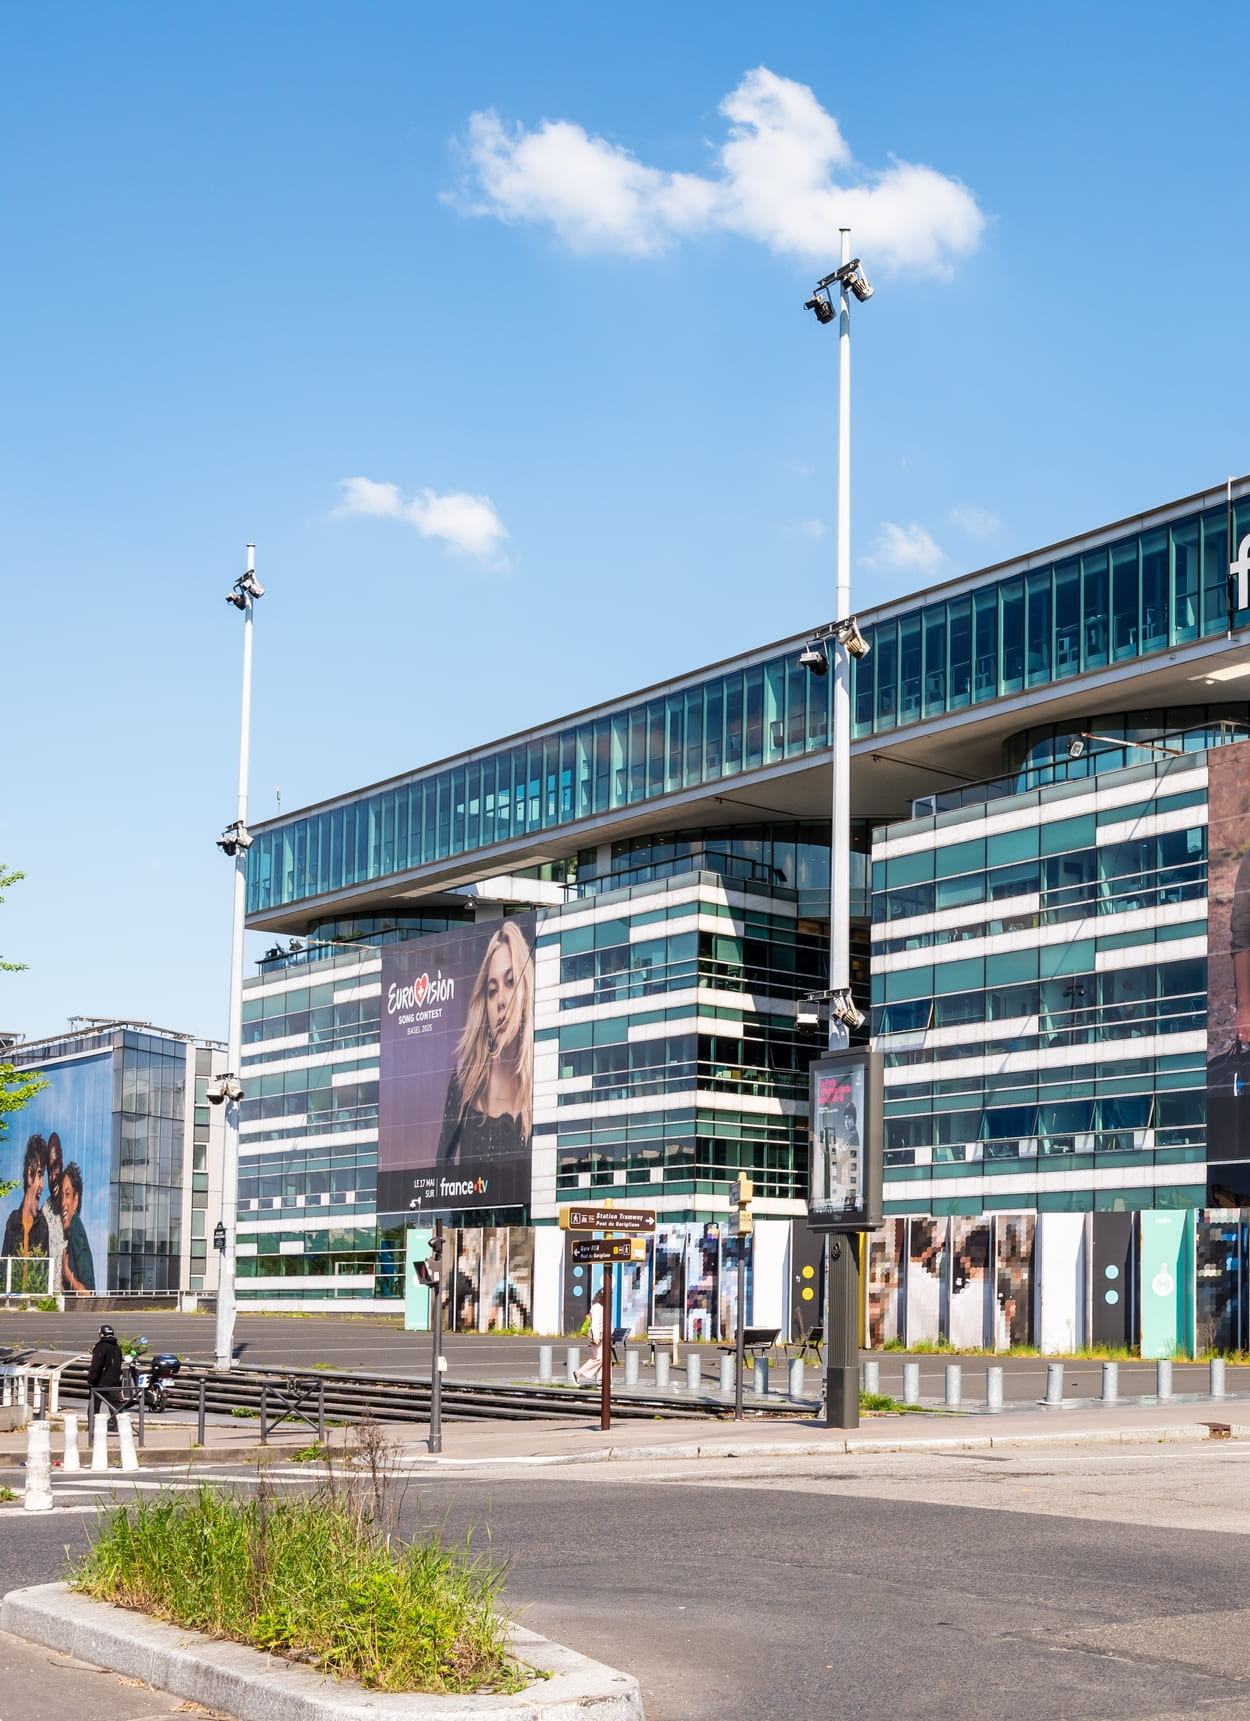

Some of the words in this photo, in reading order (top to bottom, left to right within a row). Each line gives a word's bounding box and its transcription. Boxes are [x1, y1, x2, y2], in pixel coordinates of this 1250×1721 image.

[398, 1013, 415, 1025] SONG
[415, 1008, 443, 1022] CONTEST
[407, 1026, 421, 1036] BASEL
[421, 1024, 433, 1033] 2025
[414, 1179, 420, 1188] LE
[420, 1179, 425, 1187] 17
[425, 1178, 435, 1187] MAI
[425, 1189, 435, 1198] SUR
[595, 1212, 618, 1220] Station
[619, 1213, 643, 1221] Tramway
